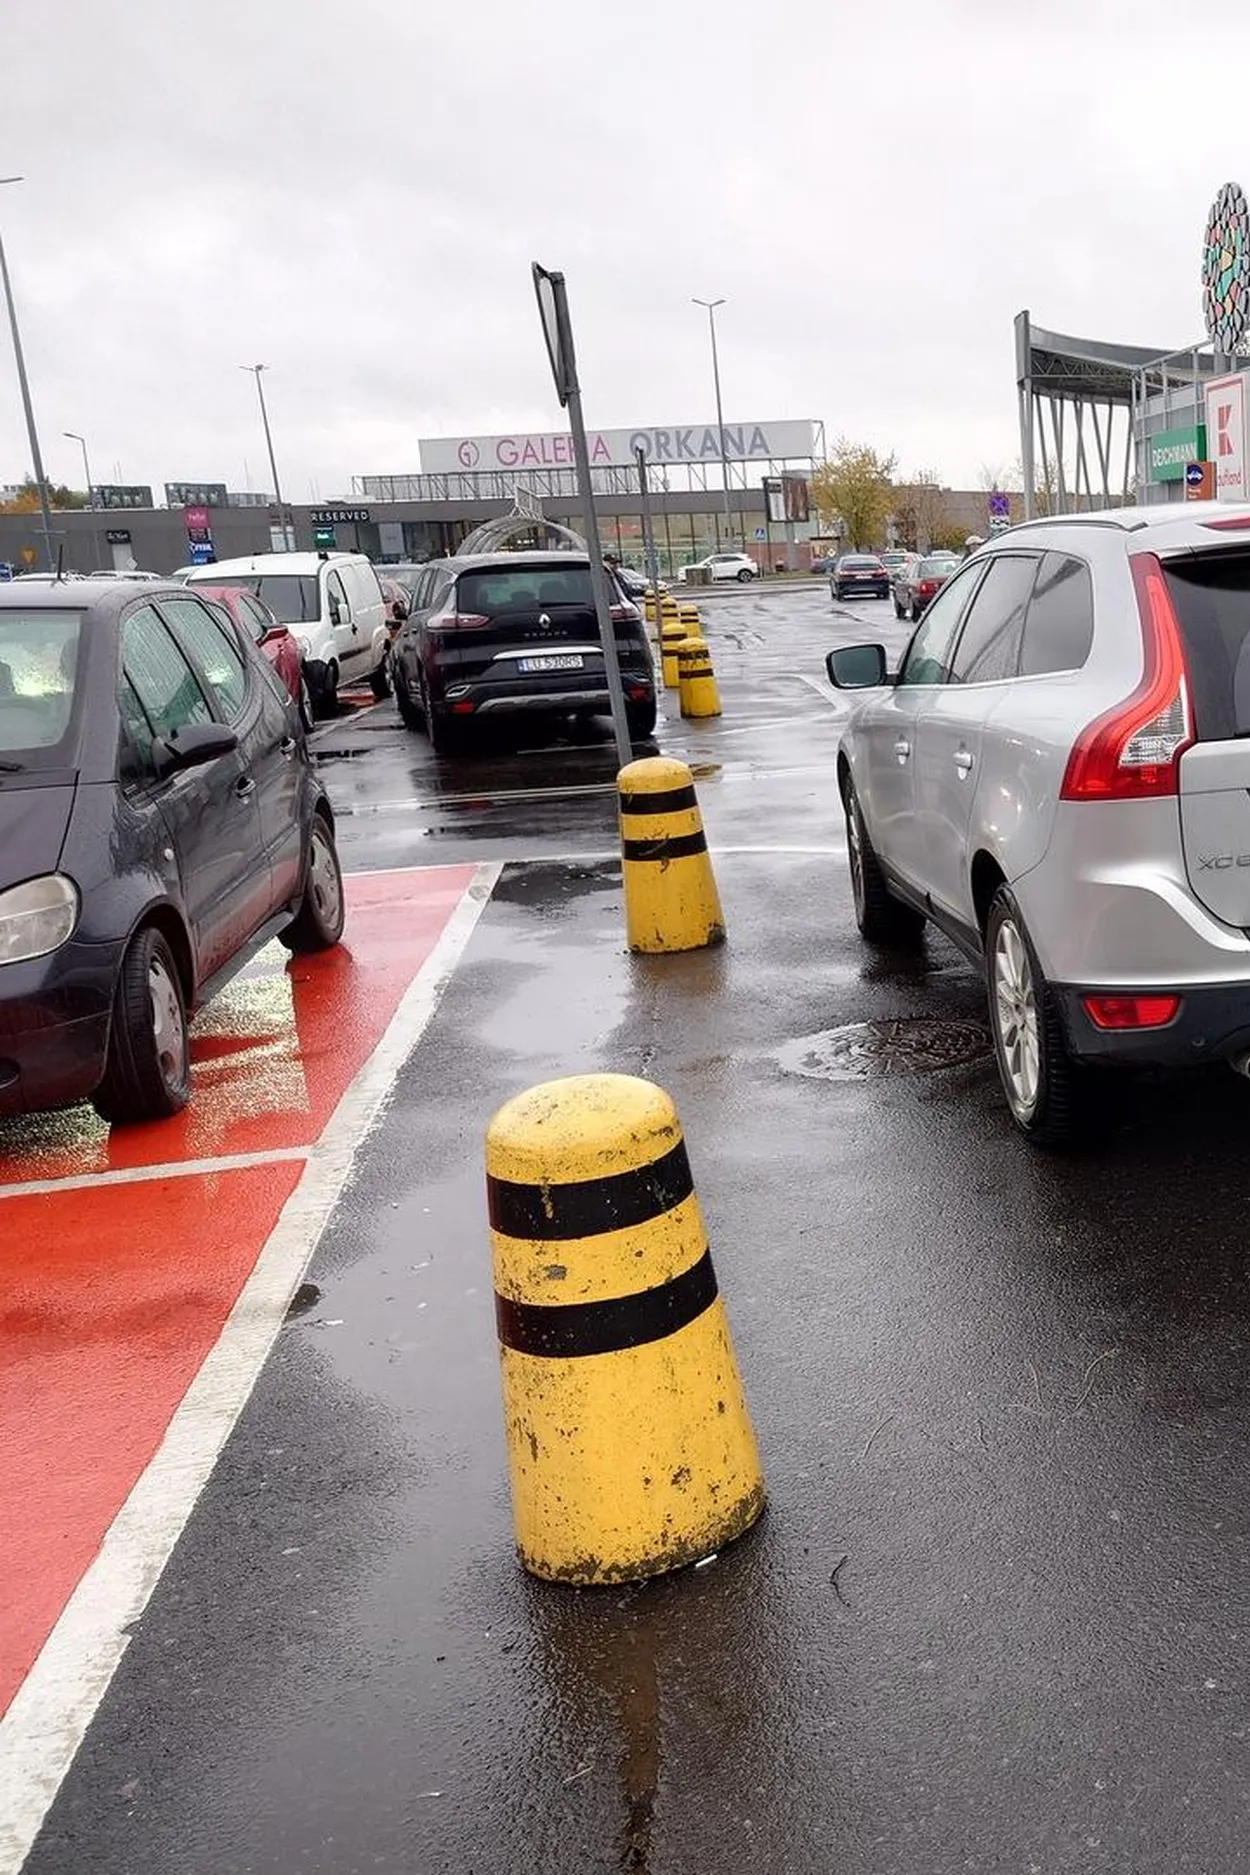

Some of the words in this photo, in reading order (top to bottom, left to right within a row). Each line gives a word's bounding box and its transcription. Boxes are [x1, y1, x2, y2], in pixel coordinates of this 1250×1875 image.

[496, 435, 612, 466] GALEA
[629, 425, 771, 461] ORKANA
[311, 511, 369, 523] RESERVED
